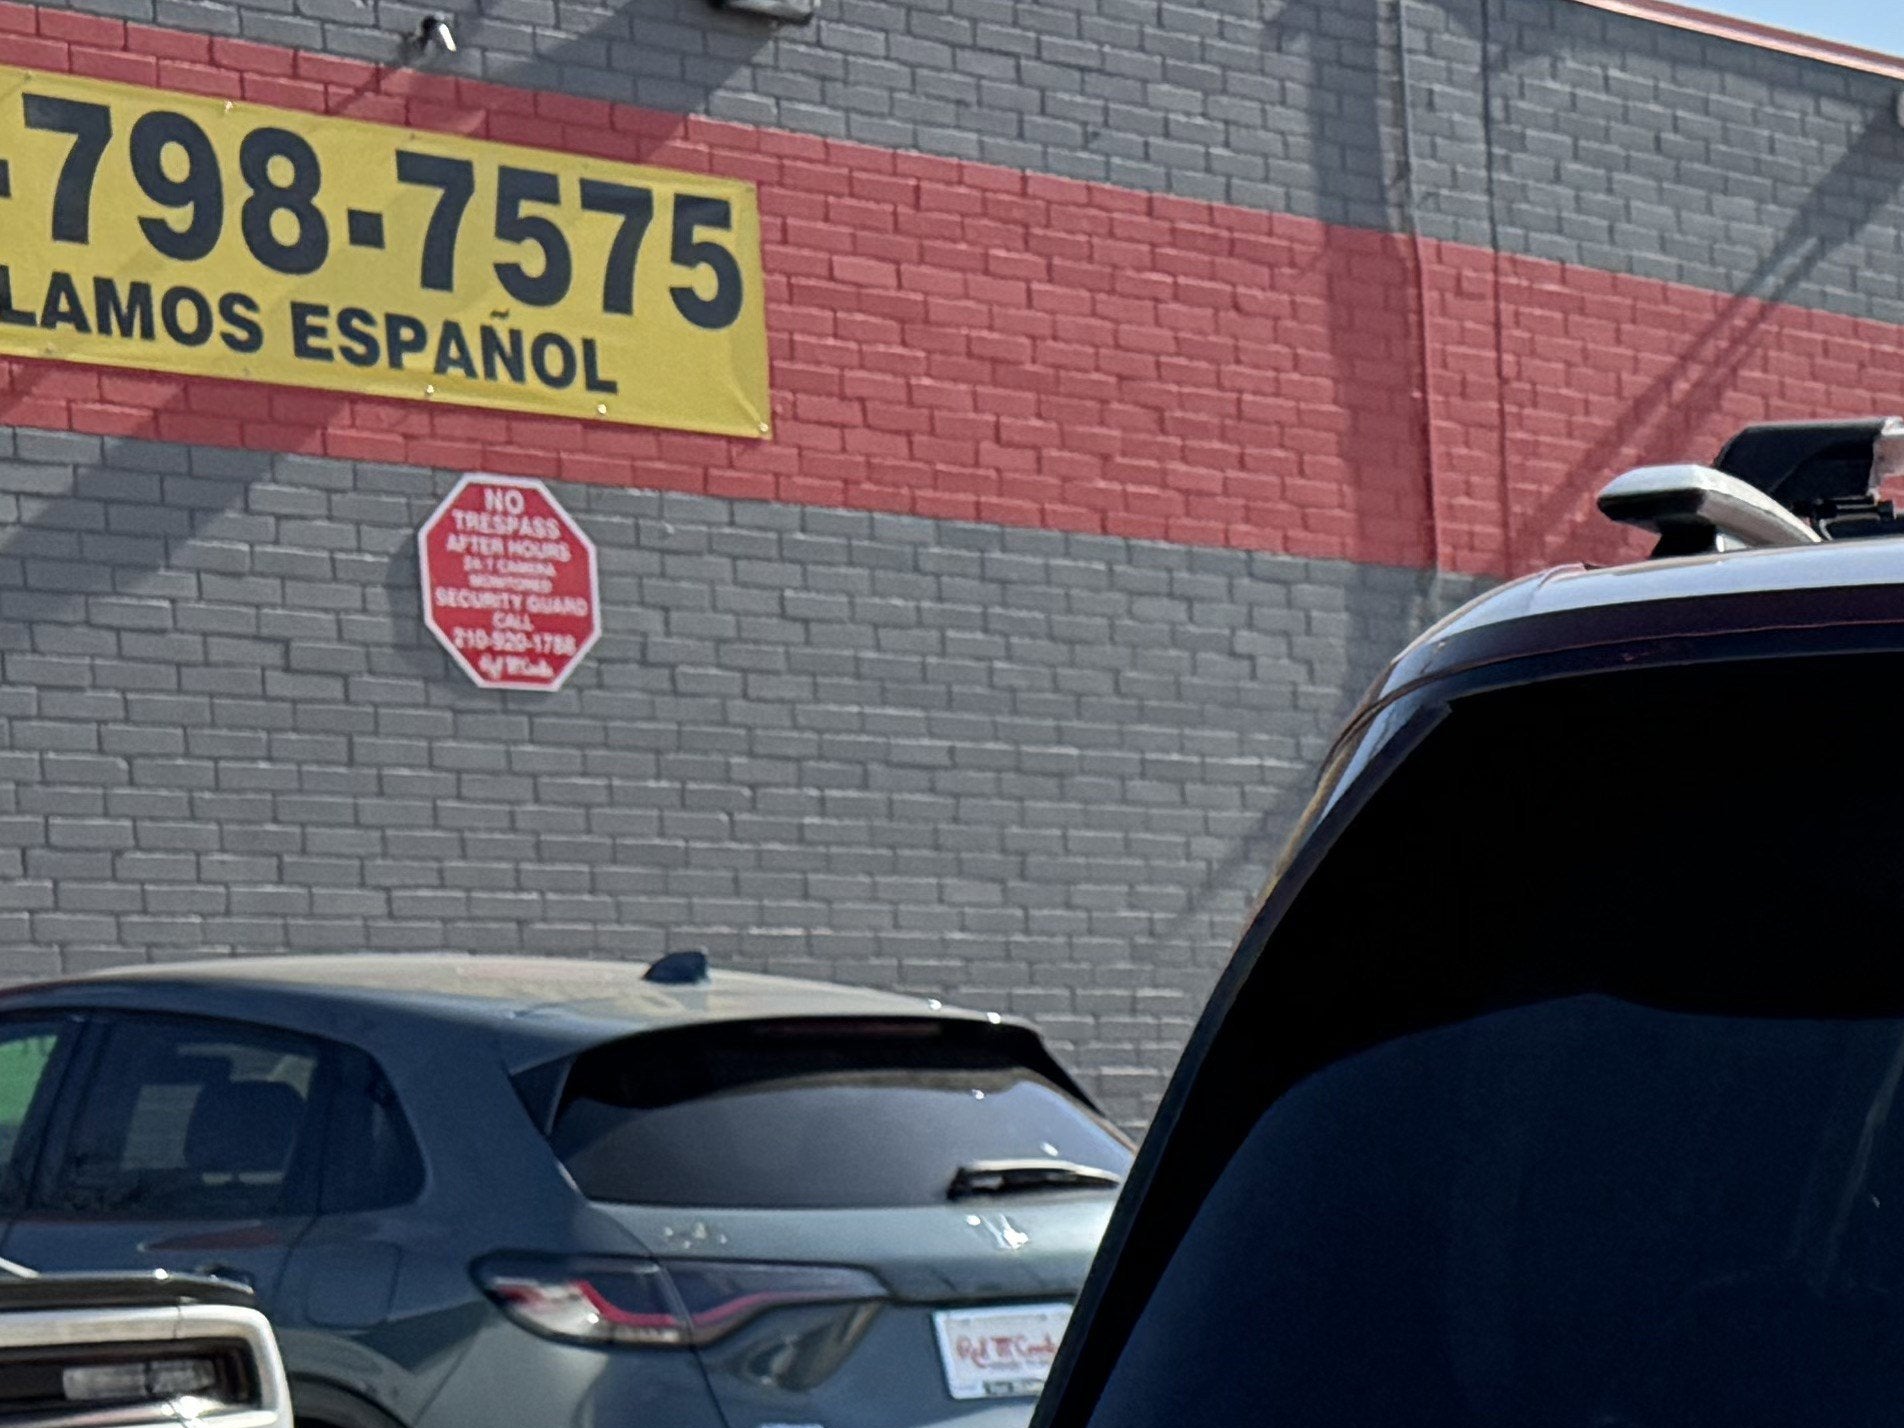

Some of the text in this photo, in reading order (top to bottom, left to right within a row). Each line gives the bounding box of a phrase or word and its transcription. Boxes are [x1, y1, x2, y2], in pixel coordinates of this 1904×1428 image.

[0, 92, 744, 330] 798-7575
[290, 301, 618, 395] ESPAÑOL
[484, 487, 525, 515] NO
[452, 508, 561, 540] TRESPASS
[446, 533, 571, 563] AFTER HOURS
[435, 586, 588, 617] SECURITY GUARD
[492, 611, 534, 631] CALL
